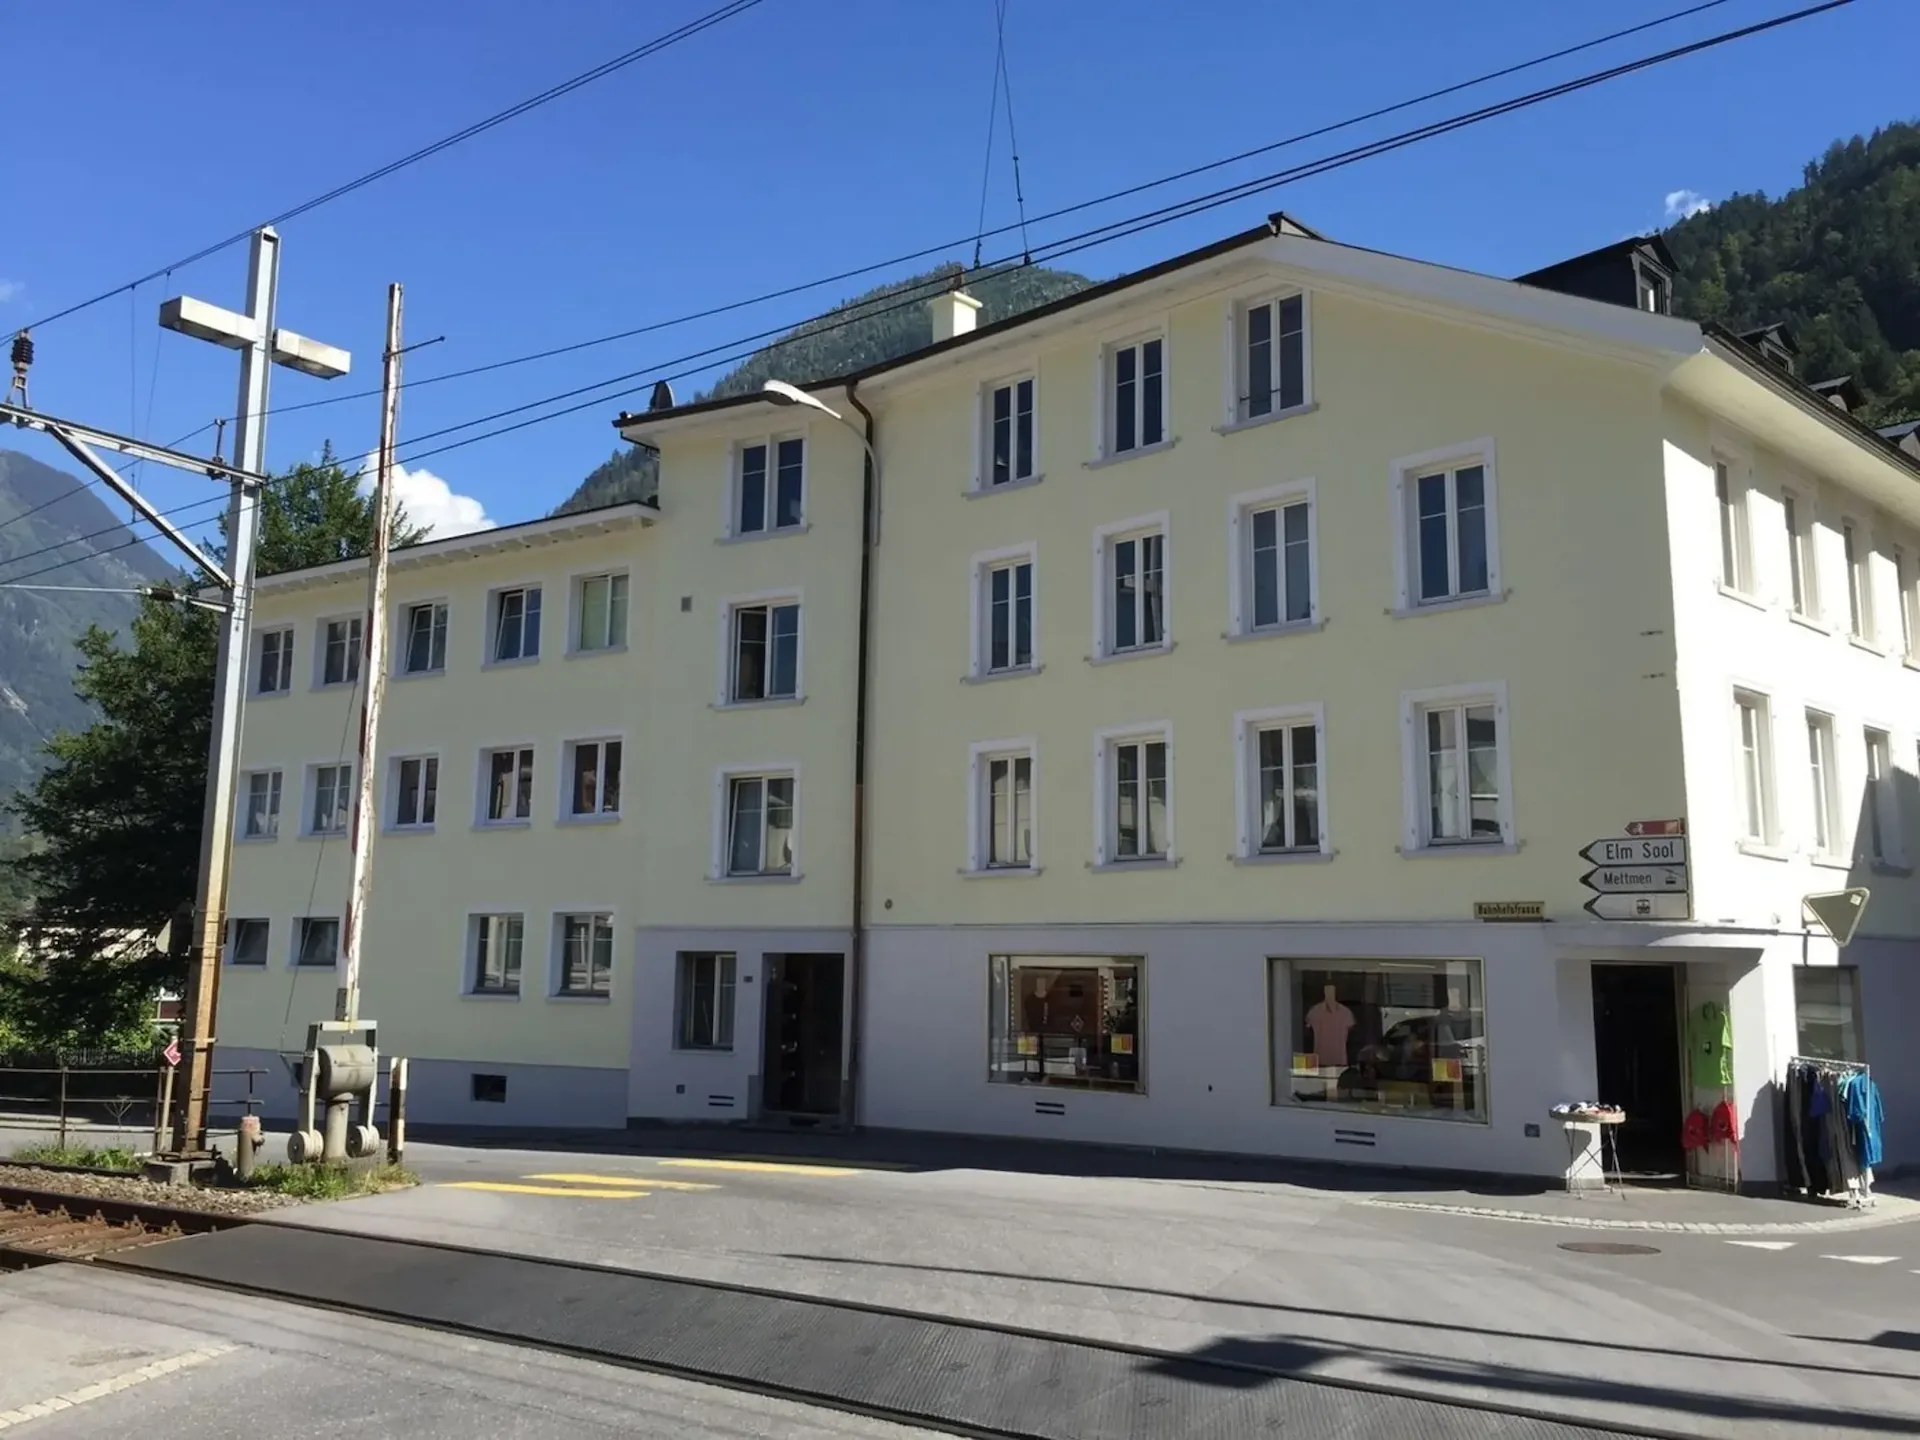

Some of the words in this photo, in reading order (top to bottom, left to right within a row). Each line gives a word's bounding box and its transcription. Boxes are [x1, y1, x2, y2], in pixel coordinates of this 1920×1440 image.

[1605, 843, 1633, 860] Elm
[1642, 841, 1674, 858] Sool
[1603, 872, 1652, 885] Mettmen
